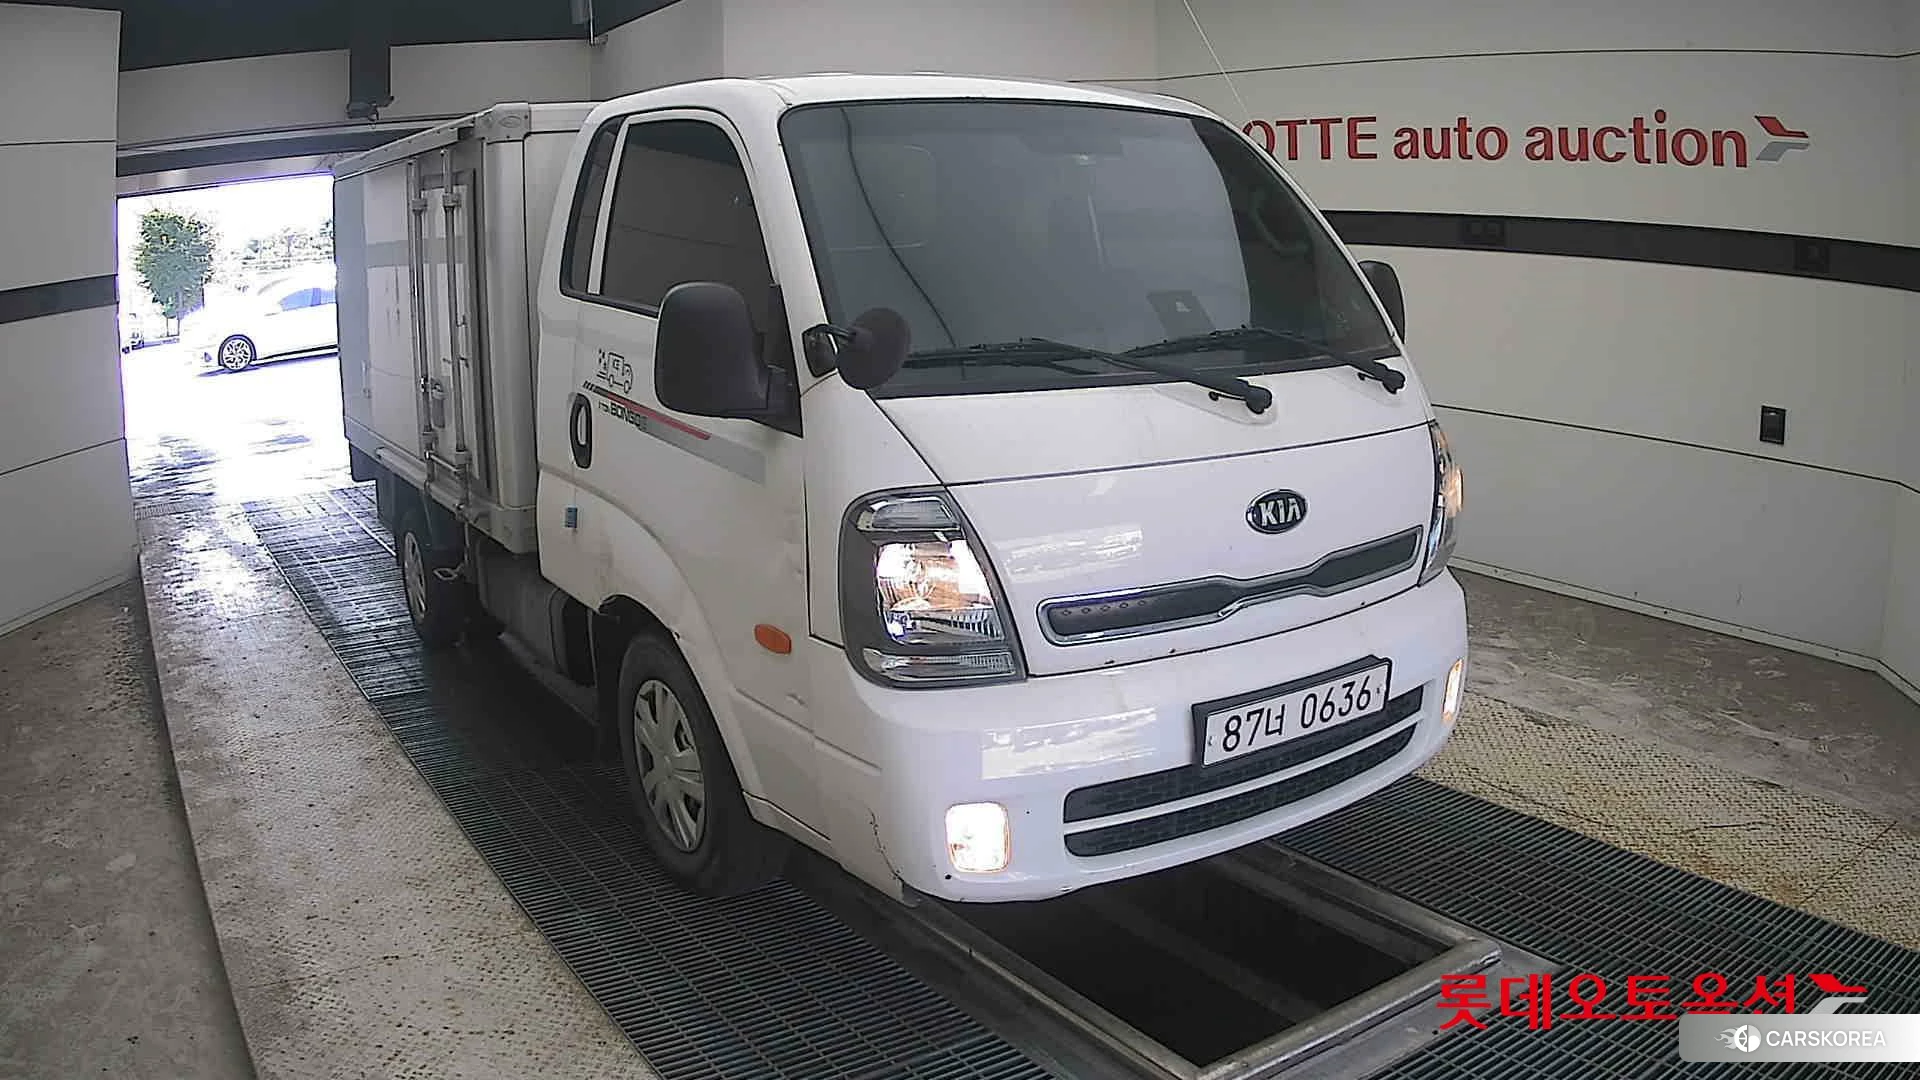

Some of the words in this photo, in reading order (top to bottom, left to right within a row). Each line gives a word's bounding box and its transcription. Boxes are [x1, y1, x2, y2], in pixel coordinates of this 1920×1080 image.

[1242, 116, 1378, 160] OTTE
[1393, 116, 1509, 160] auto
[1524, 109, 1749, 168] auction
[1259, 497, 1301, 527] KIA
[1222, 703, 1286, 752] 87너
[1301, 675, 1372, 729] 0636
